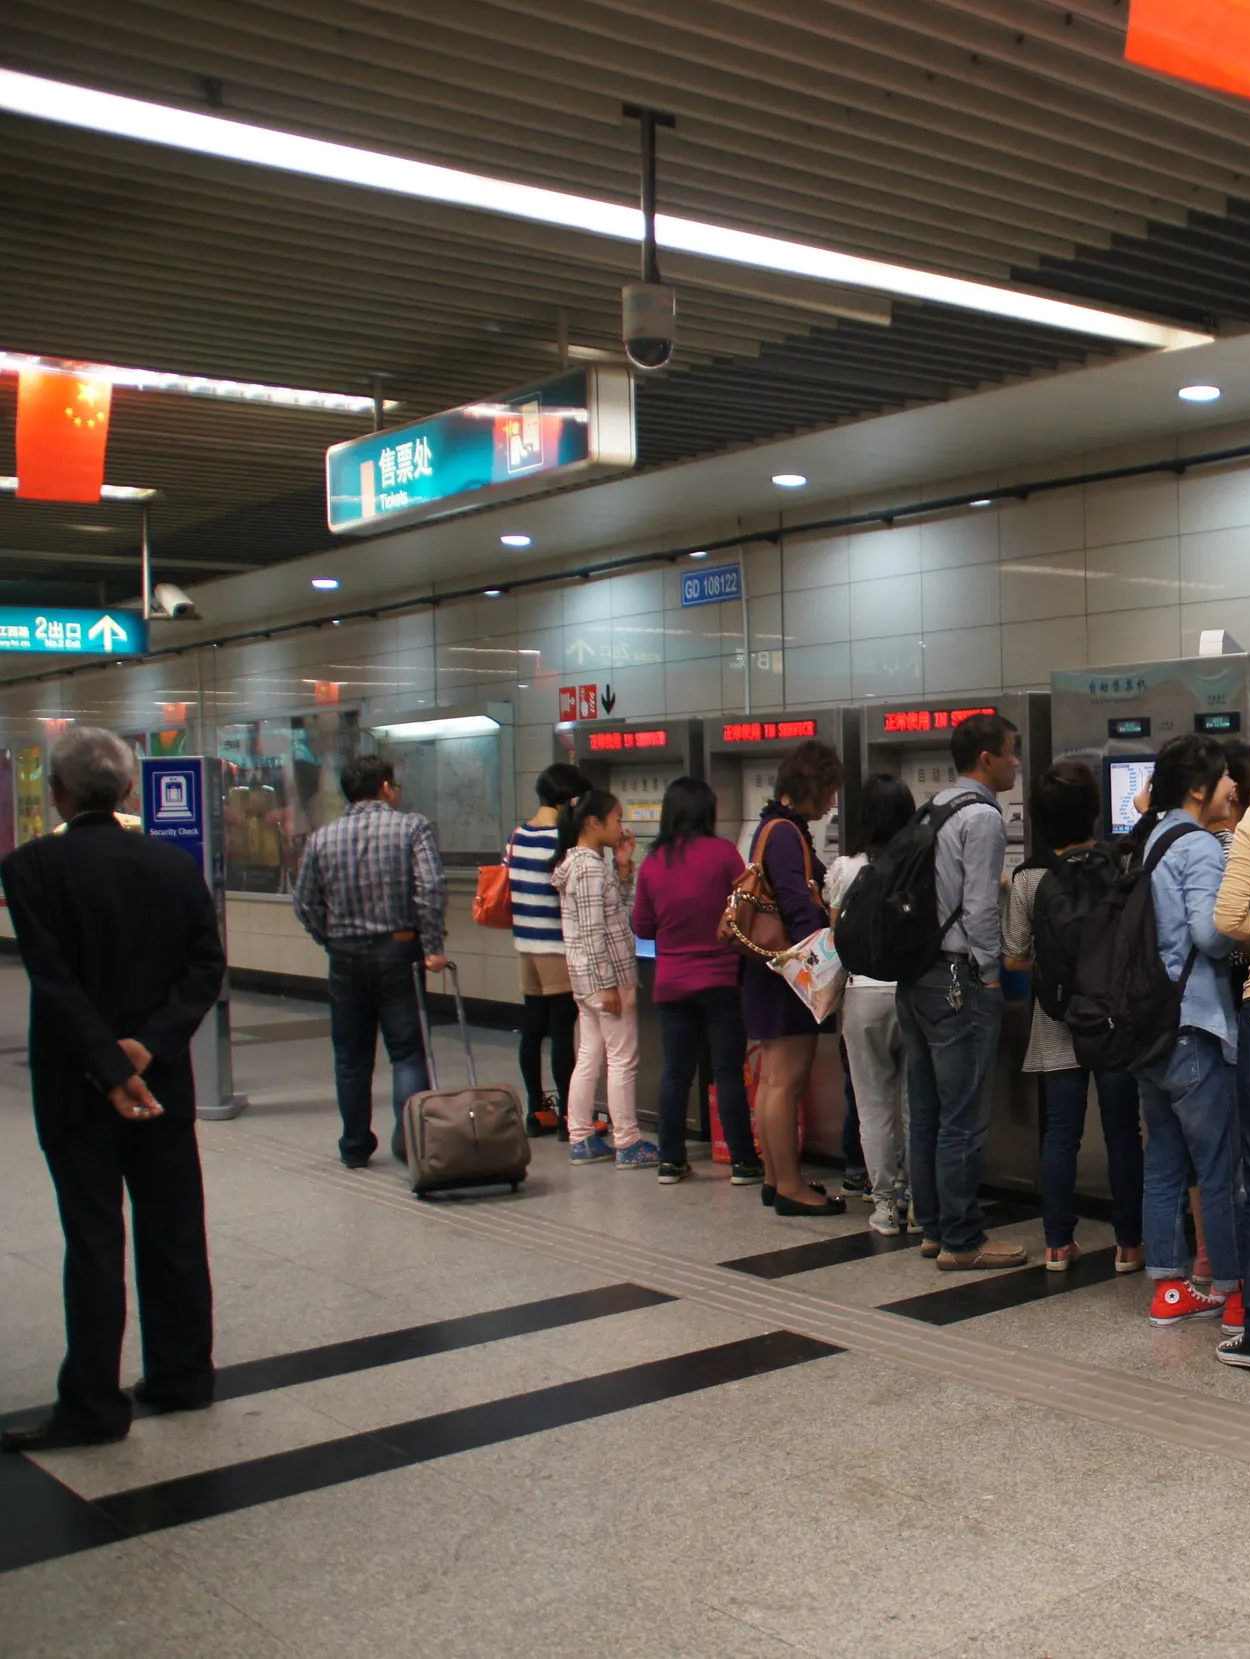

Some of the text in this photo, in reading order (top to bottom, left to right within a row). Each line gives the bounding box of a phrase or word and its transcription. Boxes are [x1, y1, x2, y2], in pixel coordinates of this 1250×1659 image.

[379, 436, 433, 488] 售票处
[379, 490, 408, 510] Tickets
[685, 572, 737, 599] GD 108122
[35, 616, 81, 639] 2出口
[884, 711, 930, 732] 正常使用
[934, 711, 949, 728] IN
[150, 827, 199, 837] Security Check
